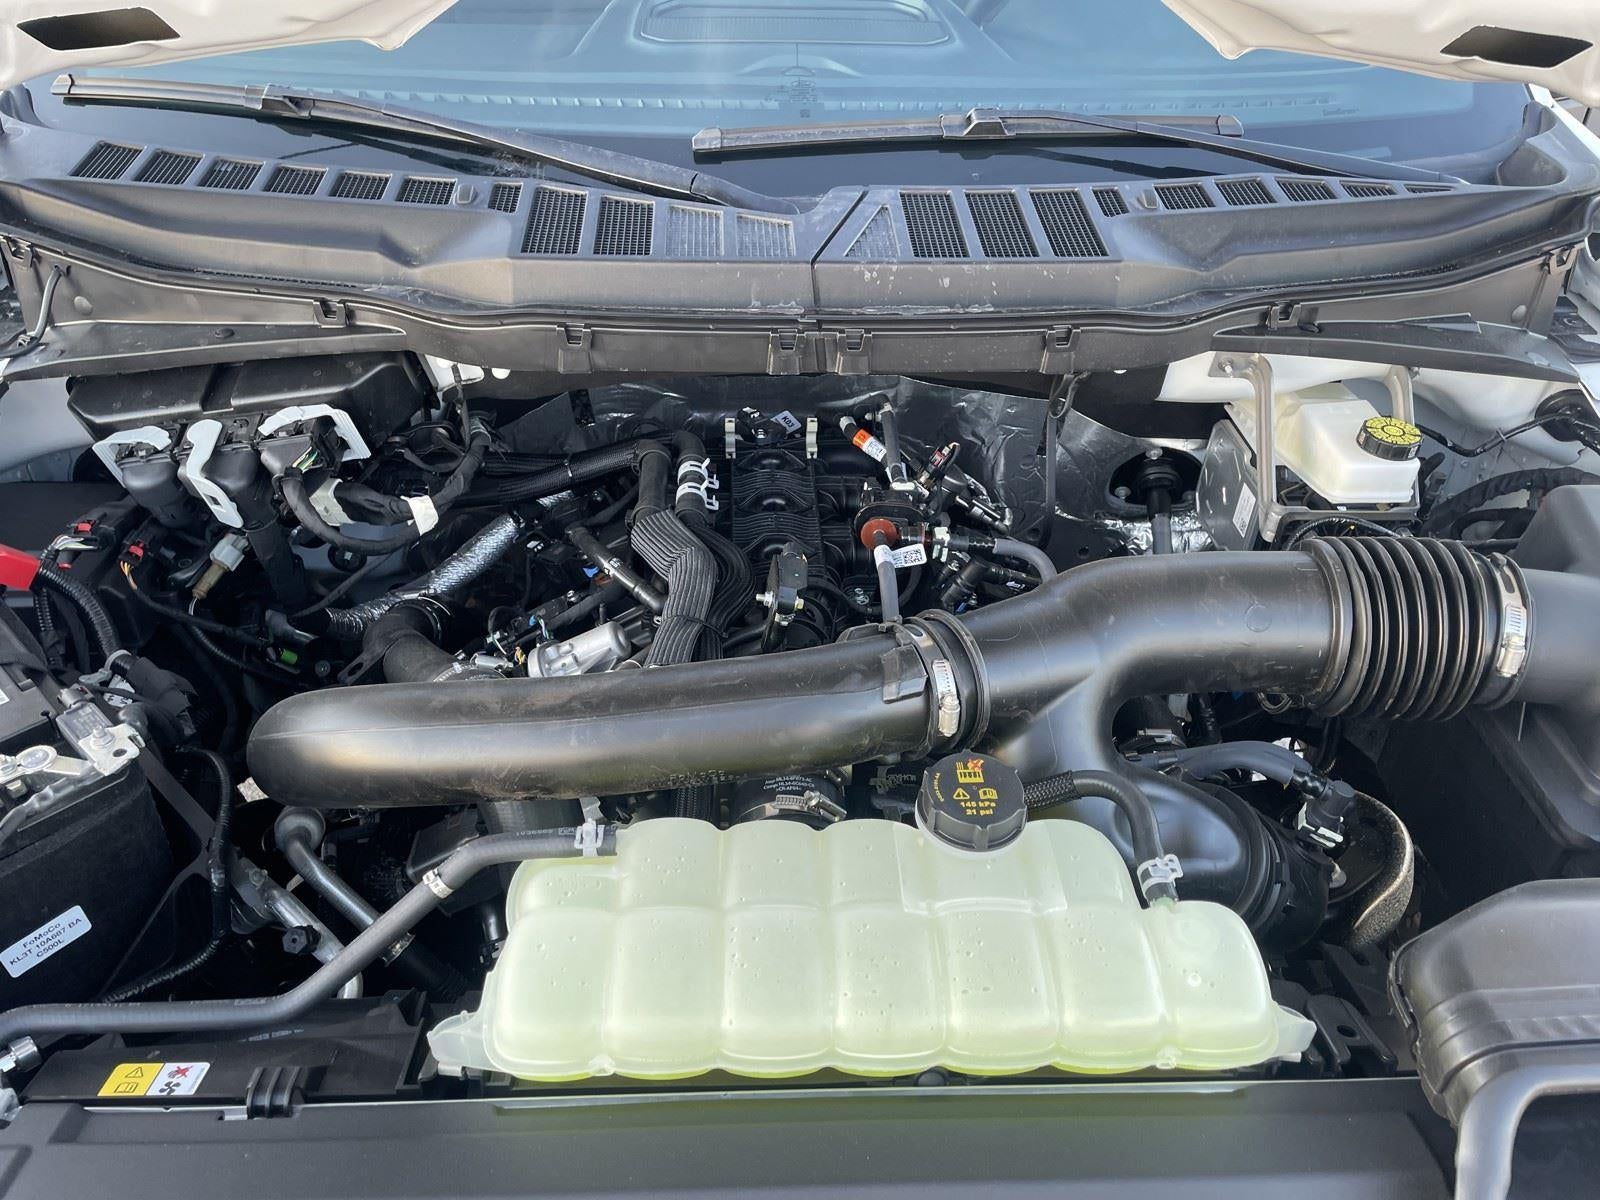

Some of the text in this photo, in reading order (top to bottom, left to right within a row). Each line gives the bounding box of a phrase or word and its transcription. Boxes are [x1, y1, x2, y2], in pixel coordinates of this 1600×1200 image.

[979, 808, 993, 816] psi
[22, 922, 61, 949] FoMoCo
[9, 949, 33, 965] KL3T
[36, 939, 65, 958] C500L
